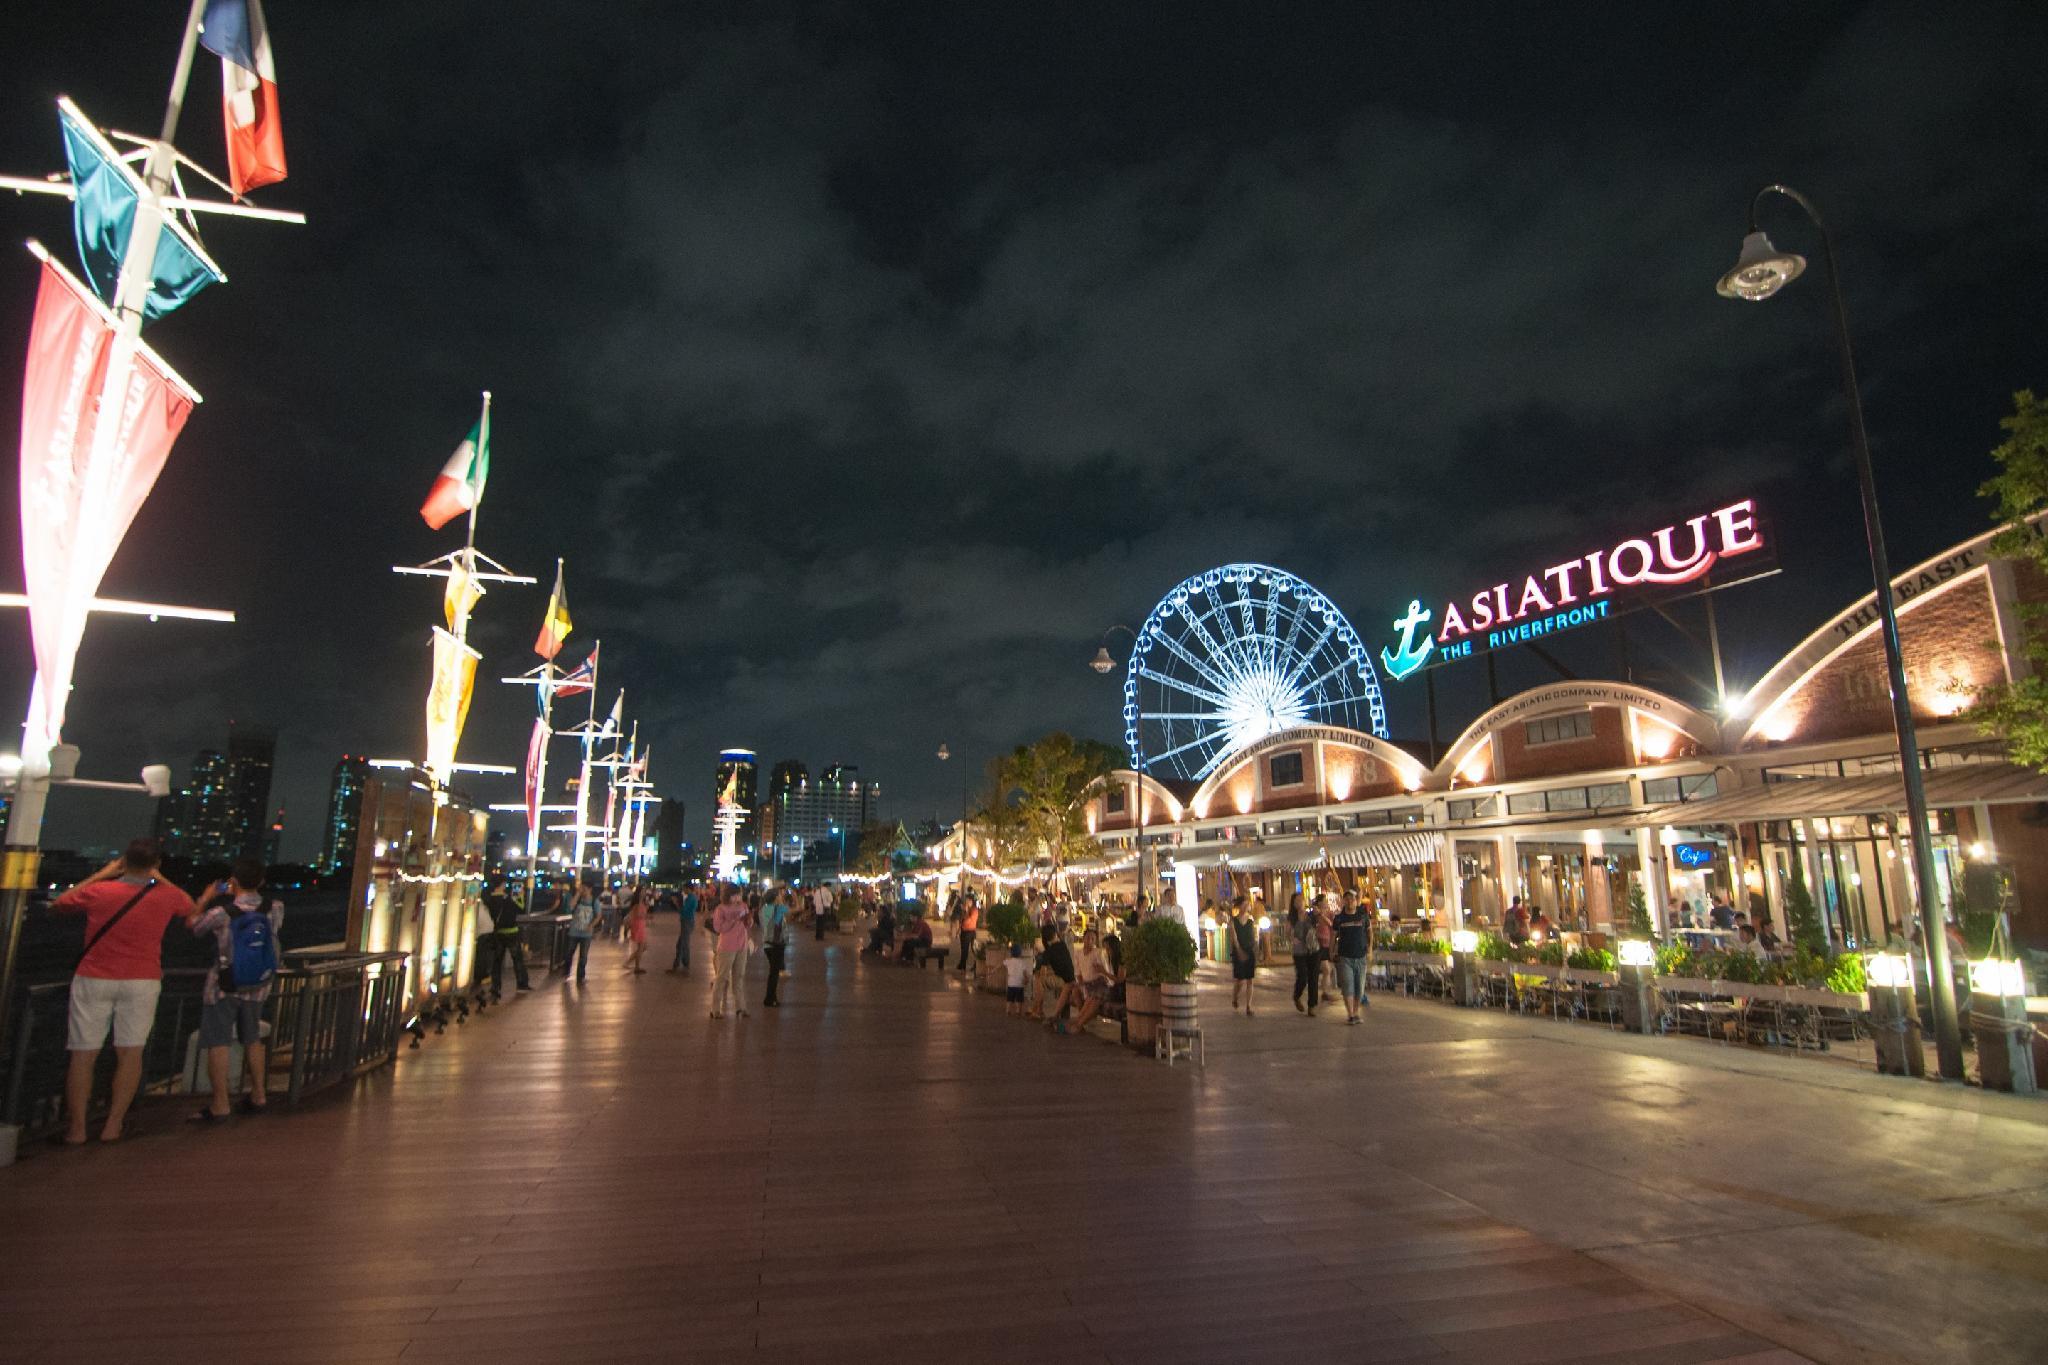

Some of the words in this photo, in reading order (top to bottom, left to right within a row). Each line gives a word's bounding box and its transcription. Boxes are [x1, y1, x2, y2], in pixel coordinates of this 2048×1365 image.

[1437, 500, 1764, 643] ASIATIQUE
[1834, 600, 1880, 637] TH
[1895, 549, 1974, 600] EAST
[1441, 640, 1472, 661] THE
[1489, 600, 1609, 648] RIVERFRONT
[1282, 728, 1327, 743] COMPANY
[1329, 729, 1375, 751] LIMITED
[1469, 725, 1485, 740] THE
[1487, 708, 1509, 727] EAST
[1512, 692, 1551, 713] ASIATIC
[1553, 687, 1610, 700] COMPANY
[1613, 690, 1662, 711] LIMITED
